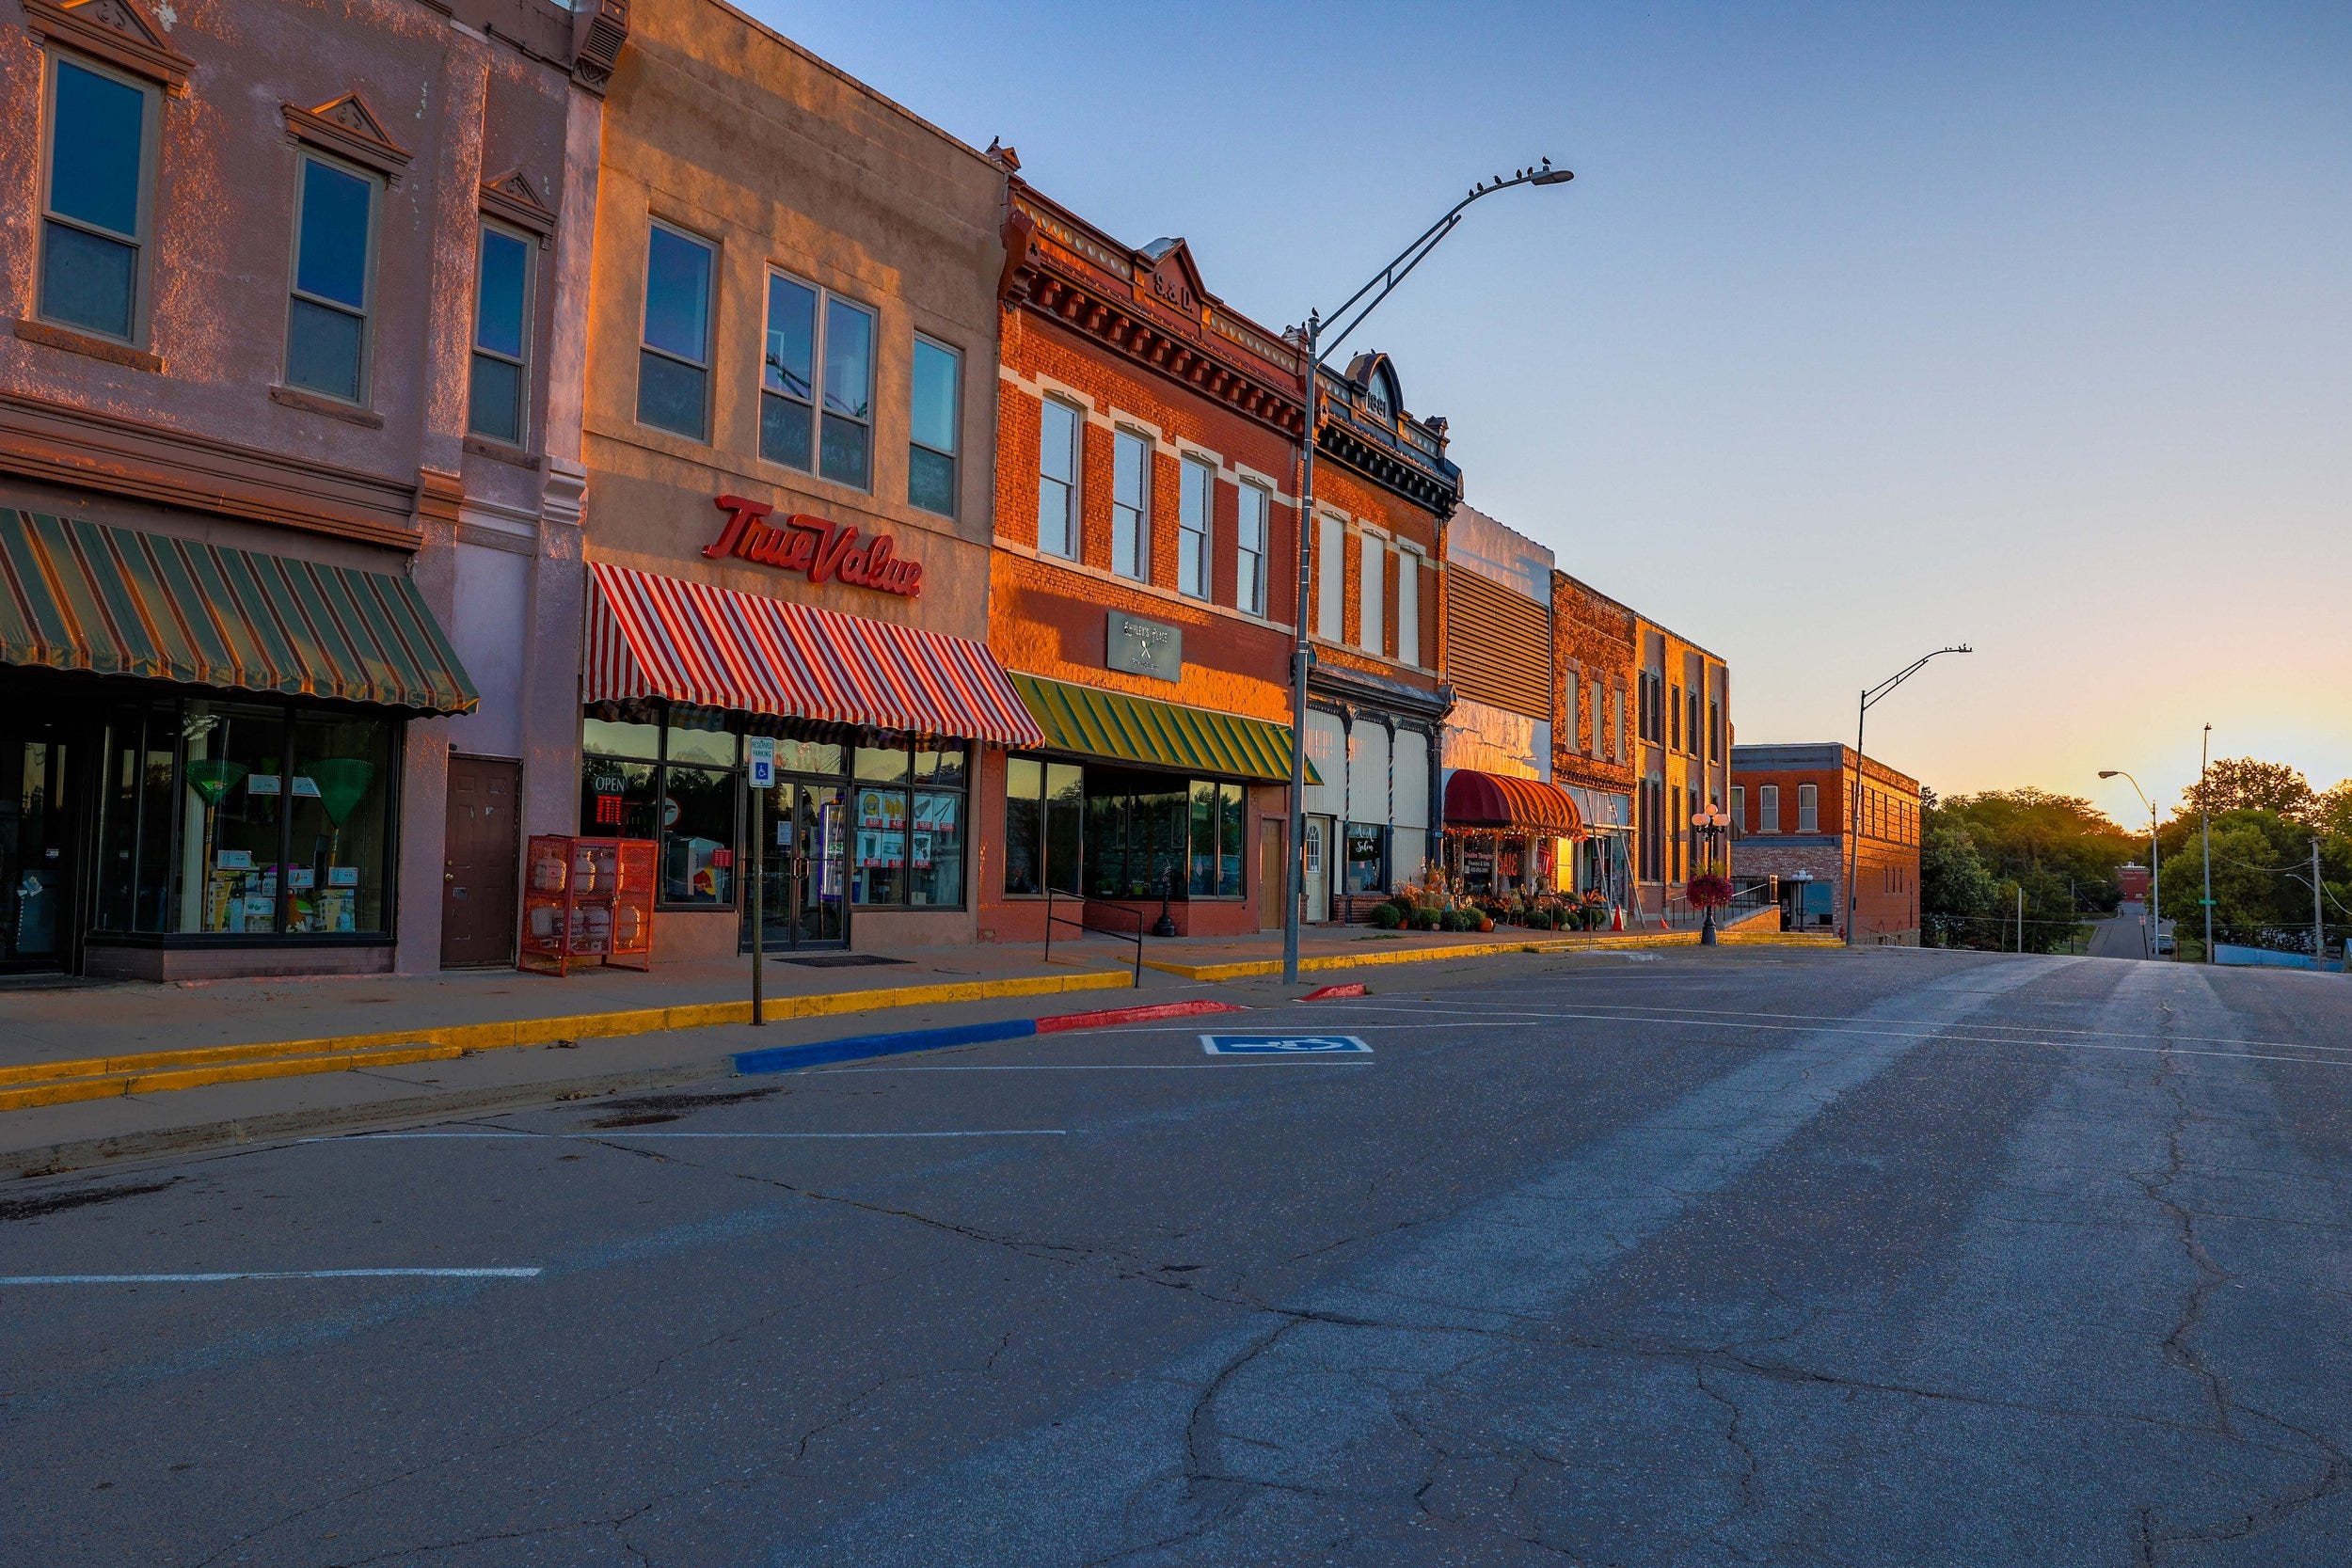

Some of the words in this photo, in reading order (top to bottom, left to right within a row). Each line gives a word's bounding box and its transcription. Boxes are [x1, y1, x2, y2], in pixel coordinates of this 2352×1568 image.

[1366, 391, 1387, 418] 1881
[701, 494, 813, 572] True
[787, 514, 922, 598] Value
[596, 776, 625, 792] OPEN
[1497, 852, 1518, 876] SALE
